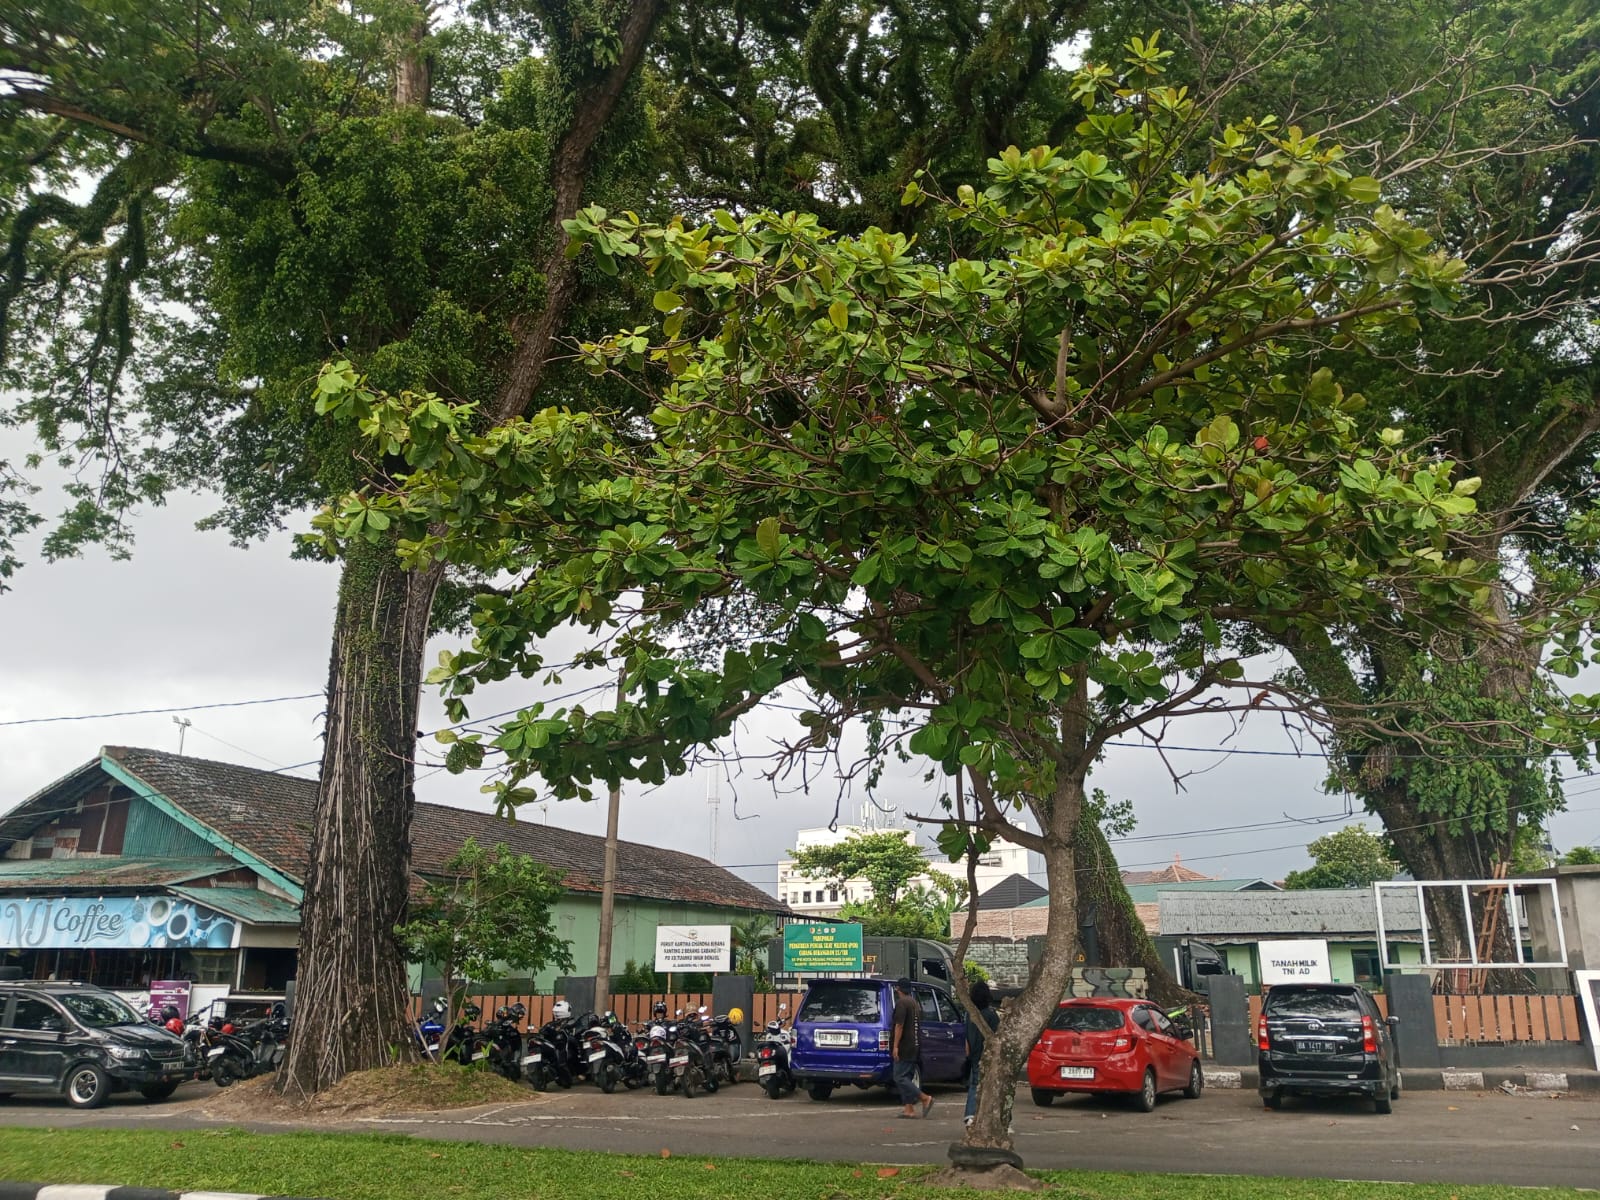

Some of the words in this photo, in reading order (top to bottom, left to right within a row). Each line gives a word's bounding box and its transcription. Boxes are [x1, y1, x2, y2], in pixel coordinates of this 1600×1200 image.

[54, 903, 122, 942] Coffee
[1271, 959, 1298, 967] TANAH
[1299, 959, 1318, 967] MILIK
[1299, 967, 1310, 975] AD
